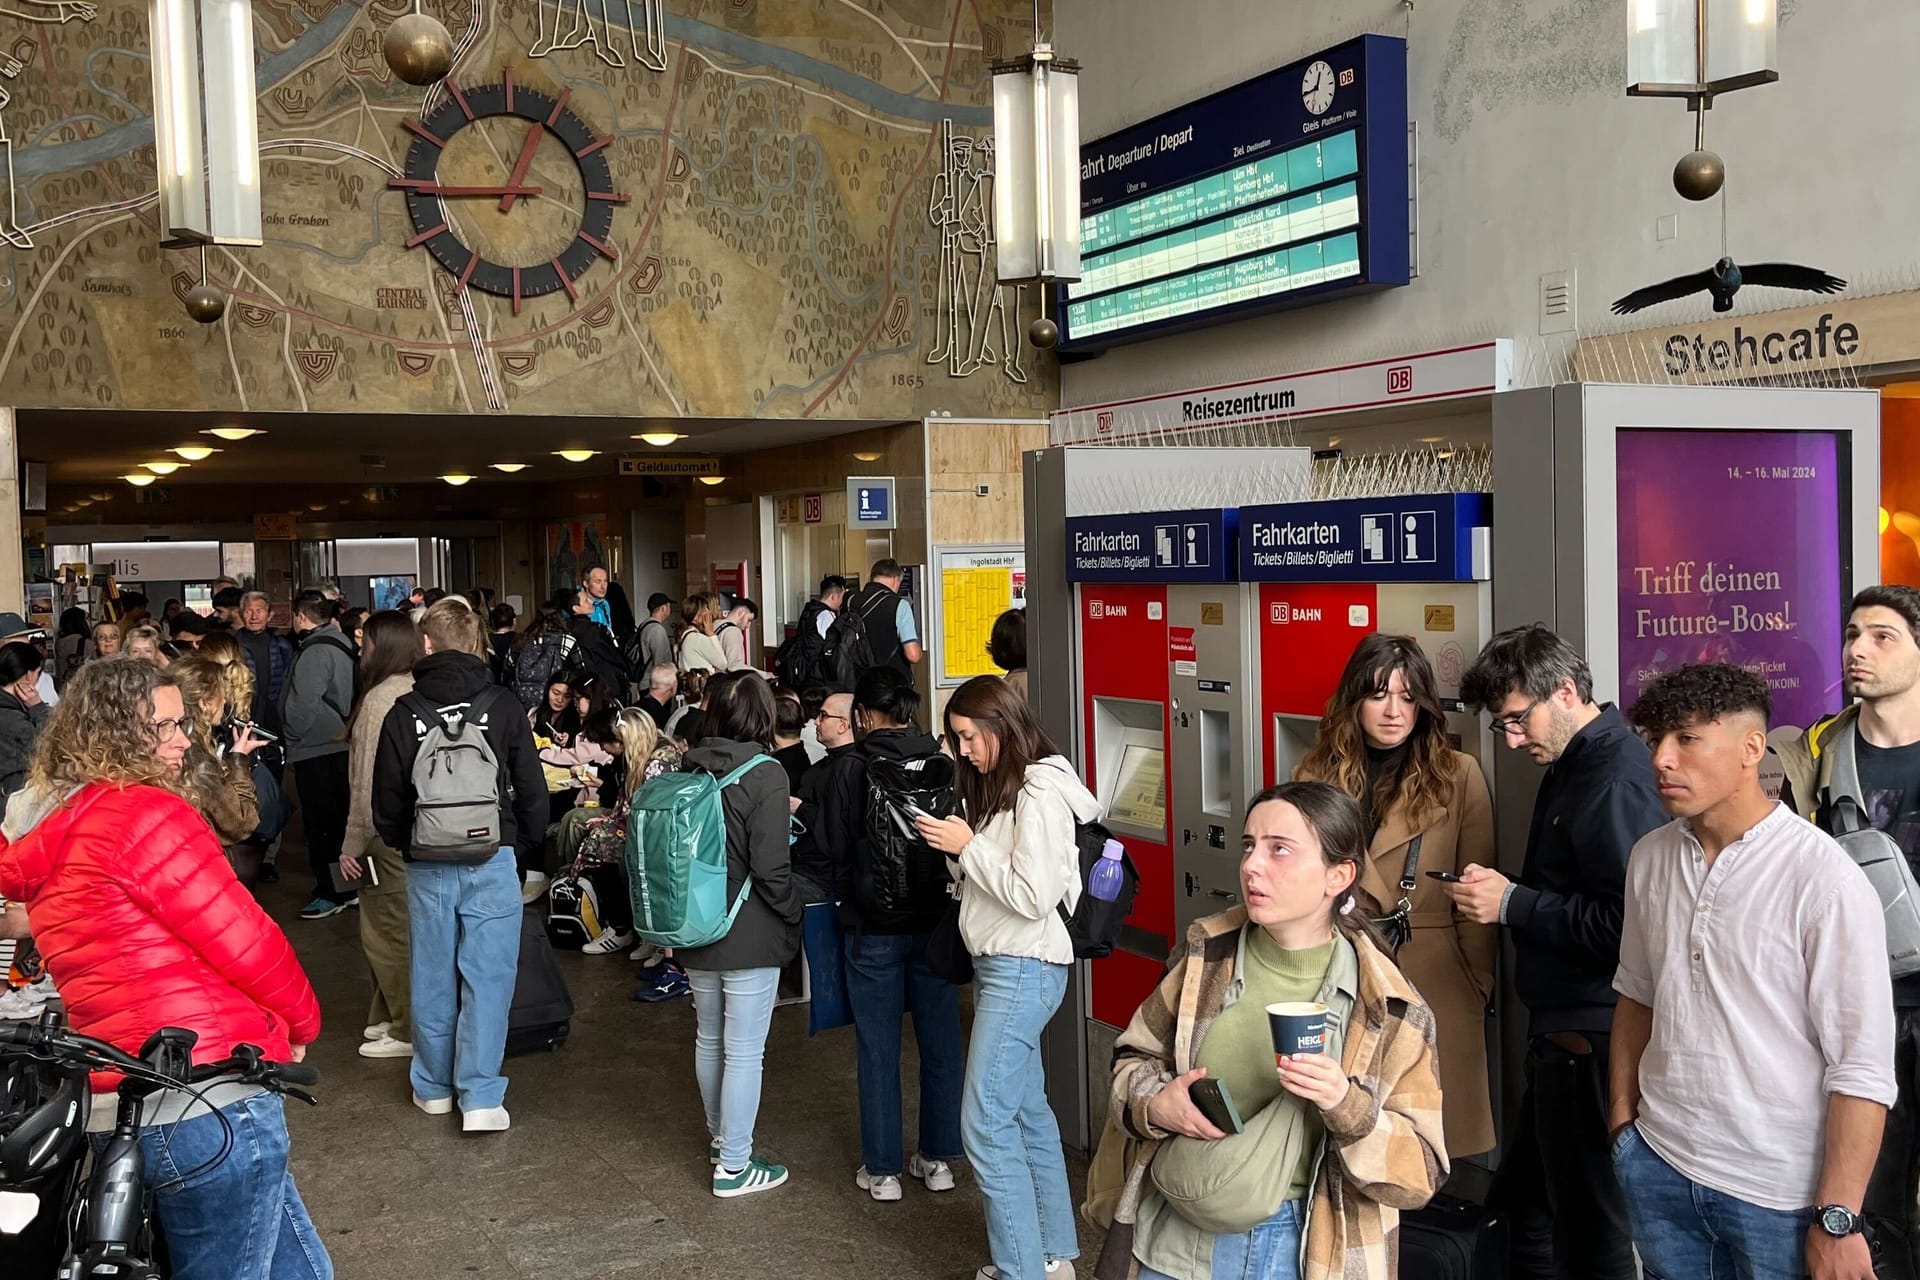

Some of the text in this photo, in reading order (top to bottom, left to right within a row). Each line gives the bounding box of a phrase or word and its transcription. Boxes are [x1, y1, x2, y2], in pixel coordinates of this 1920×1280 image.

[1340, 69, 1354, 86] DB
[1302, 120, 1320, 133] Gleis
[1108, 143, 1152, 170] Departure
[1154, 136, 1159, 154] /
[1160, 124, 1193, 151] Depart
[1233, 145, 1245, 157] Ziel
[1246, 163, 1258, 177] Hbf
[1262, 171, 1274, 183] Hbf
[1126, 182, 1139, 193] Über
[1316, 192, 1321, 204] 5
[1265, 204, 1280, 217] Nord
[288, 213, 330, 227] Graben
[1317, 242, 1322, 254] 7
[1234, 254, 1276, 275] Augsburg Hbf
[376, 287, 425, 299] CENTRAL
[376, 298, 428, 309] BAHNHOF
[158, 327, 185, 339] 1866
[1664, 313, 1859, 377] Stehcafe
[892, 374, 924, 389] 1865
[1388, 367, 1411, 393] DB
[1181, 388, 1296, 422] Reisezentrum
[637, 460, 711, 472] Geldautomat
[1727, 466, 1743, 479] 14.
[1754, 466, 1770, 479] 16.
[1772, 466, 1790, 479] Mai
[1792, 466, 1816, 479] 2024
[805, 497, 821, 521] DB
[1252, 521, 1340, 546] Fahrkarten
[1075, 531, 1140, 552] Fahrkarten
[970, 557, 1015, 567] Ingolstadt Hbf
[1075, 555, 1151, 571] Tickets/Billets/Biglietti
[1252, 549, 1354, 568] Tickets/Billets/Biglietti
[1634, 561, 1782, 595] Triff deinen
[1090, 600, 1127, 618] DB BAHN
[1271, 603, 1322, 624] DB BAHN
[1635, 601, 1790, 638] Future-Boss!
